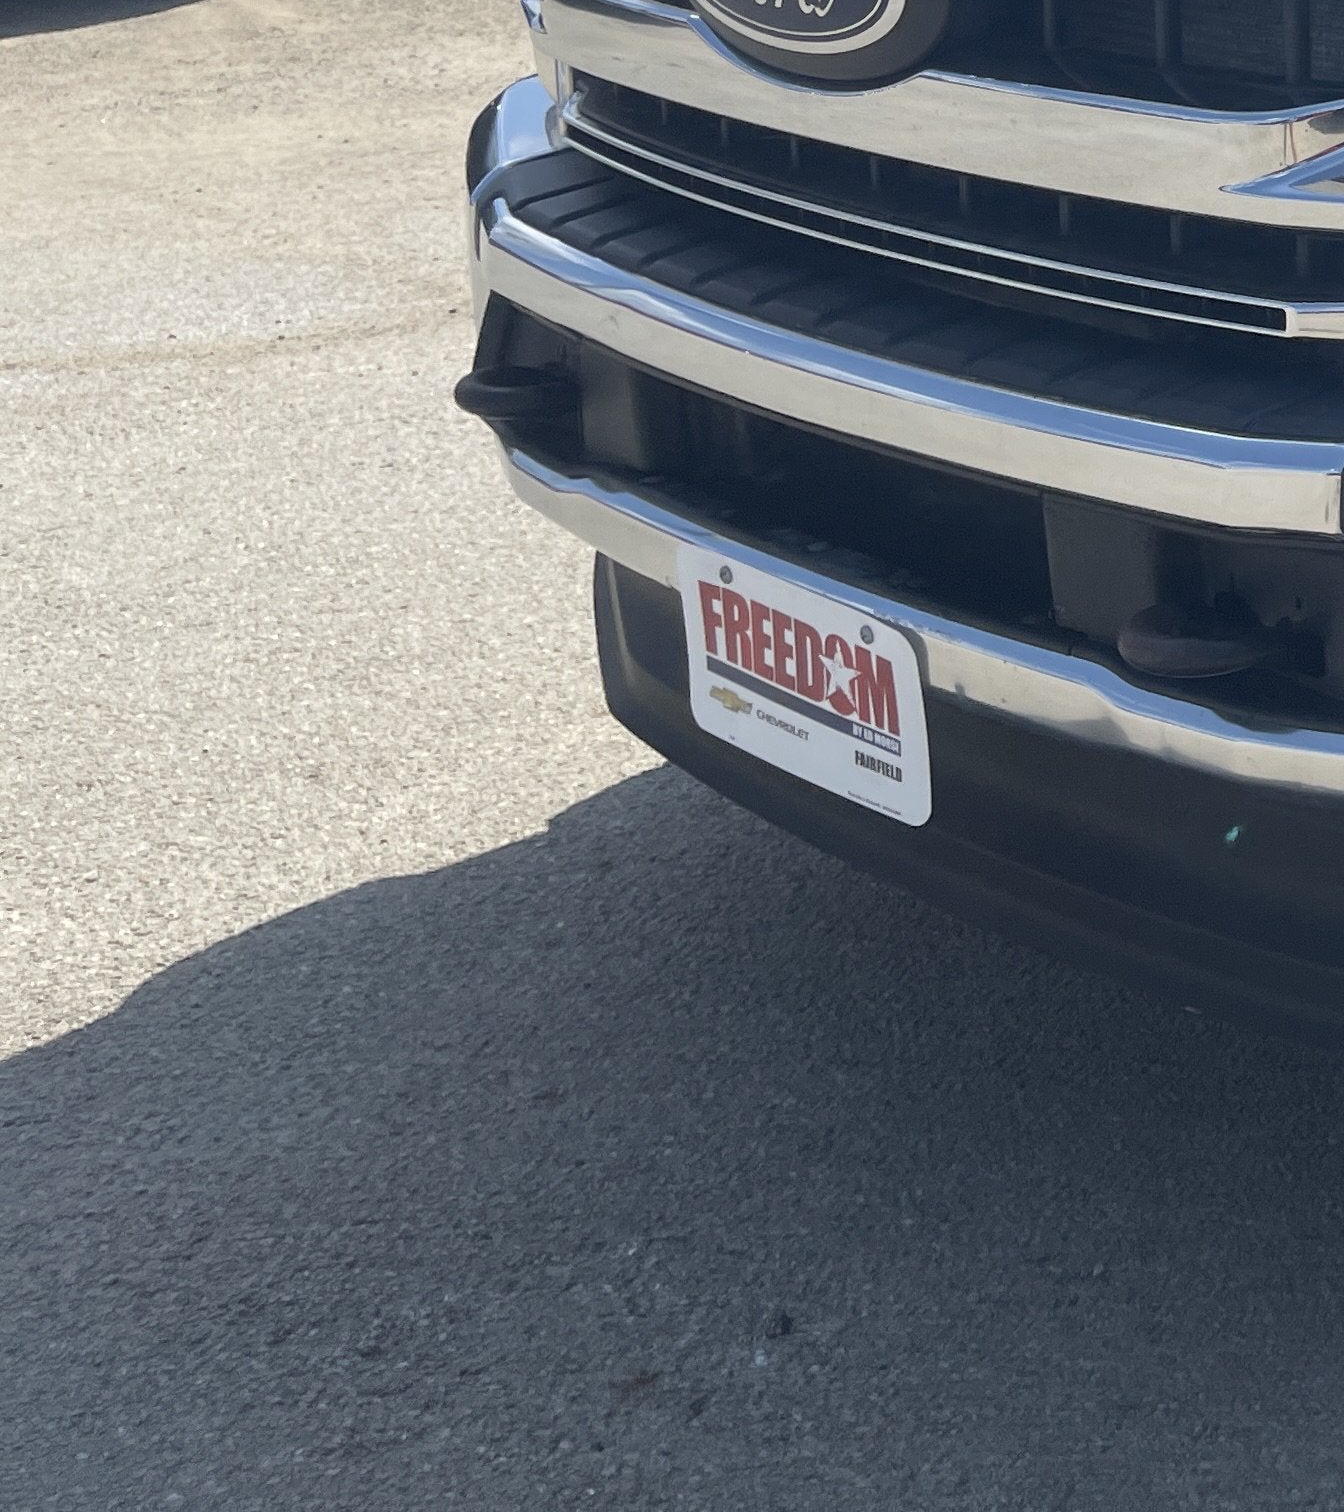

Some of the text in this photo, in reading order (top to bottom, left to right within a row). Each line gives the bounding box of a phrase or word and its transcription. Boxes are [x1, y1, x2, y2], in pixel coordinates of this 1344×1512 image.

[697, 579, 900, 737] FREEDOM
[756, 709, 809, 741] CHEVROLET
[855, 750, 902, 783] FAIRFIELD
